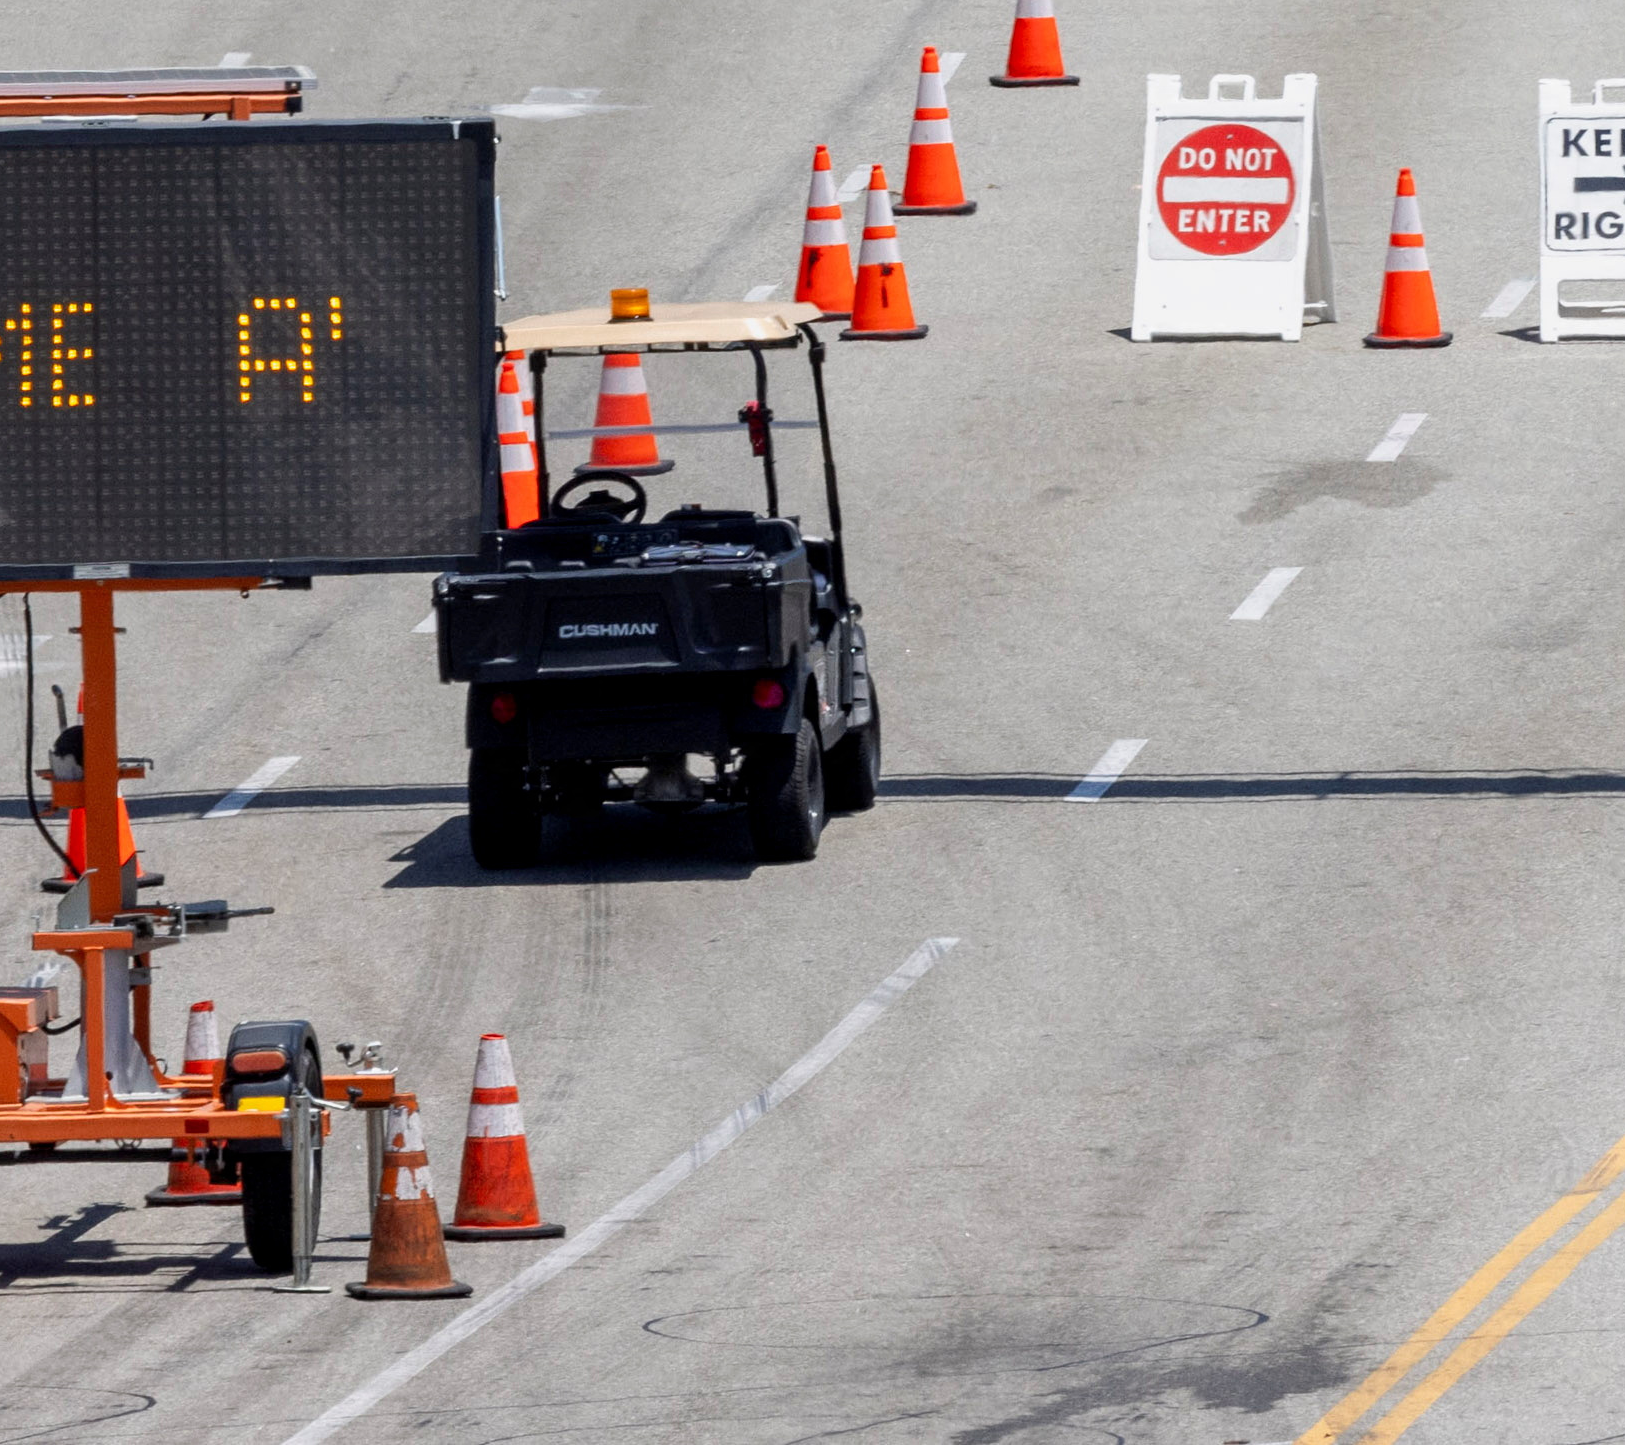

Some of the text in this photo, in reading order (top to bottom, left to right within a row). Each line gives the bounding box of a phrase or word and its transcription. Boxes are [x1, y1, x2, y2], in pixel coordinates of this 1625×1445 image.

[1178, 145, 1278, 172] DO NOT
[1178, 207, 1271, 234] ENTER
[558, 622, 659, 640] CUSHMAN
